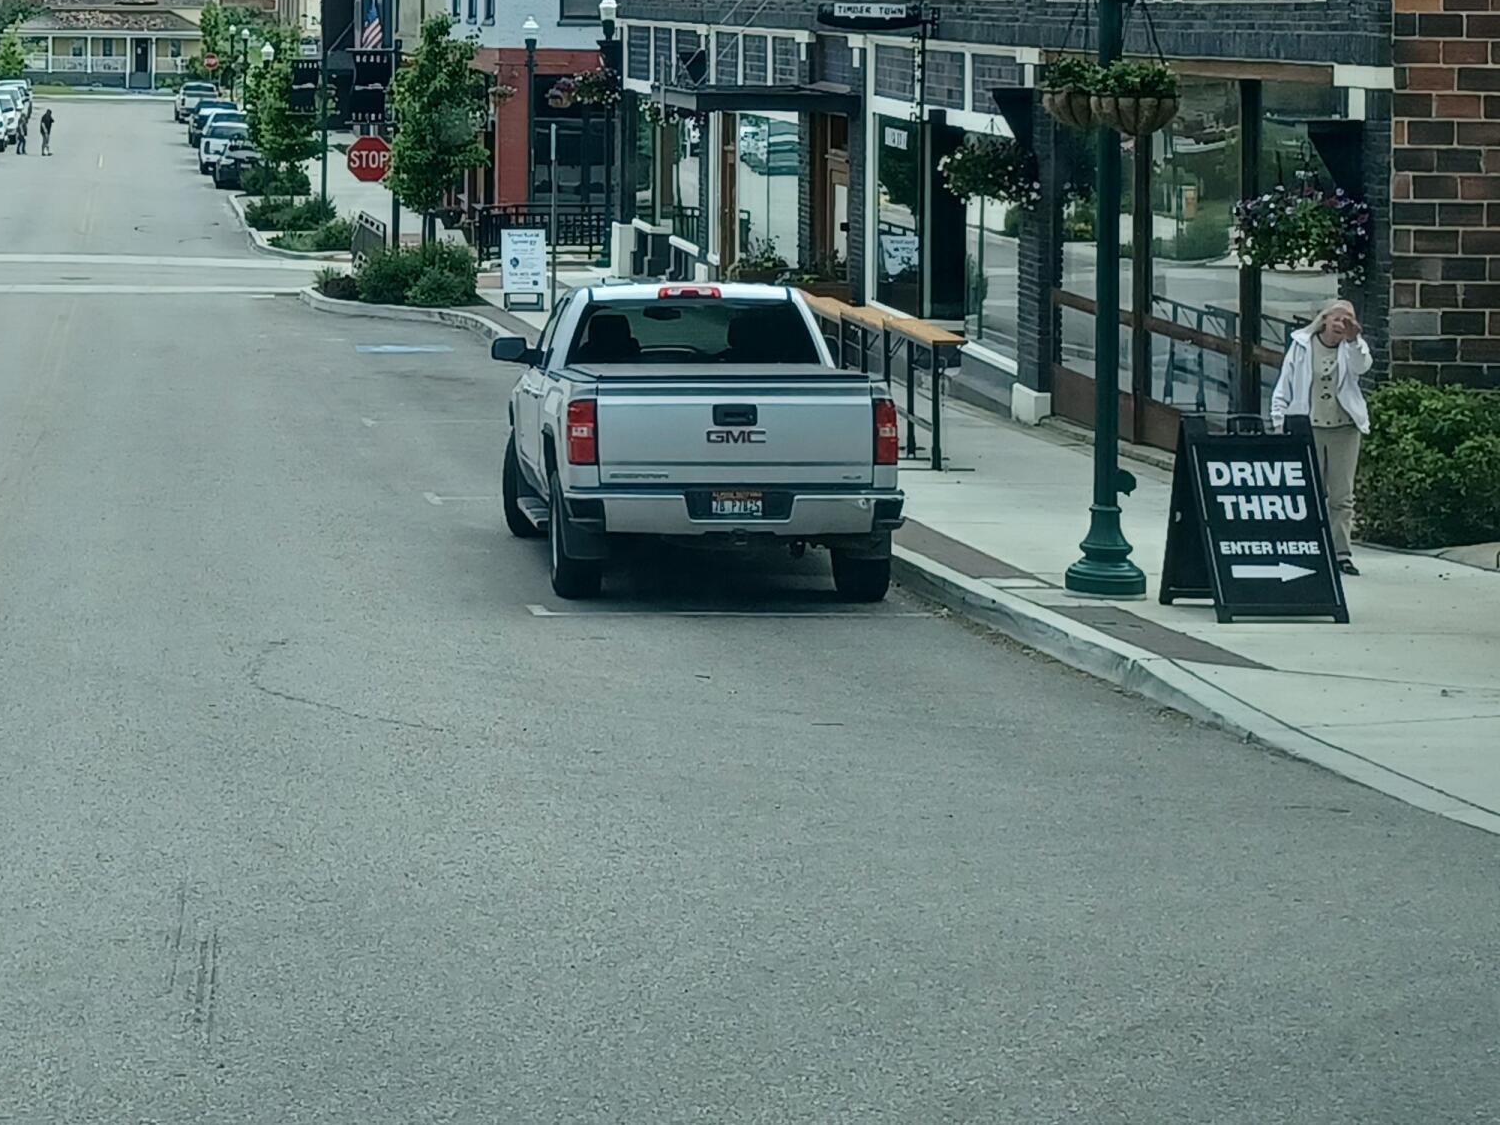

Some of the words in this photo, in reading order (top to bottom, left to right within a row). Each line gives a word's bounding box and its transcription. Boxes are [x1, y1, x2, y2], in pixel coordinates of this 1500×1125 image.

[879, 6, 904, 15] TOWN
[350, 151, 389, 168] STOP
[706, 430, 766, 443] GMC
[1206, 461, 1306, 486] DRIVE
[1216, 495, 1308, 521] THRU
[1219, 541, 1274, 555] ENTER
[1276, 541, 1321, 555] HERE
